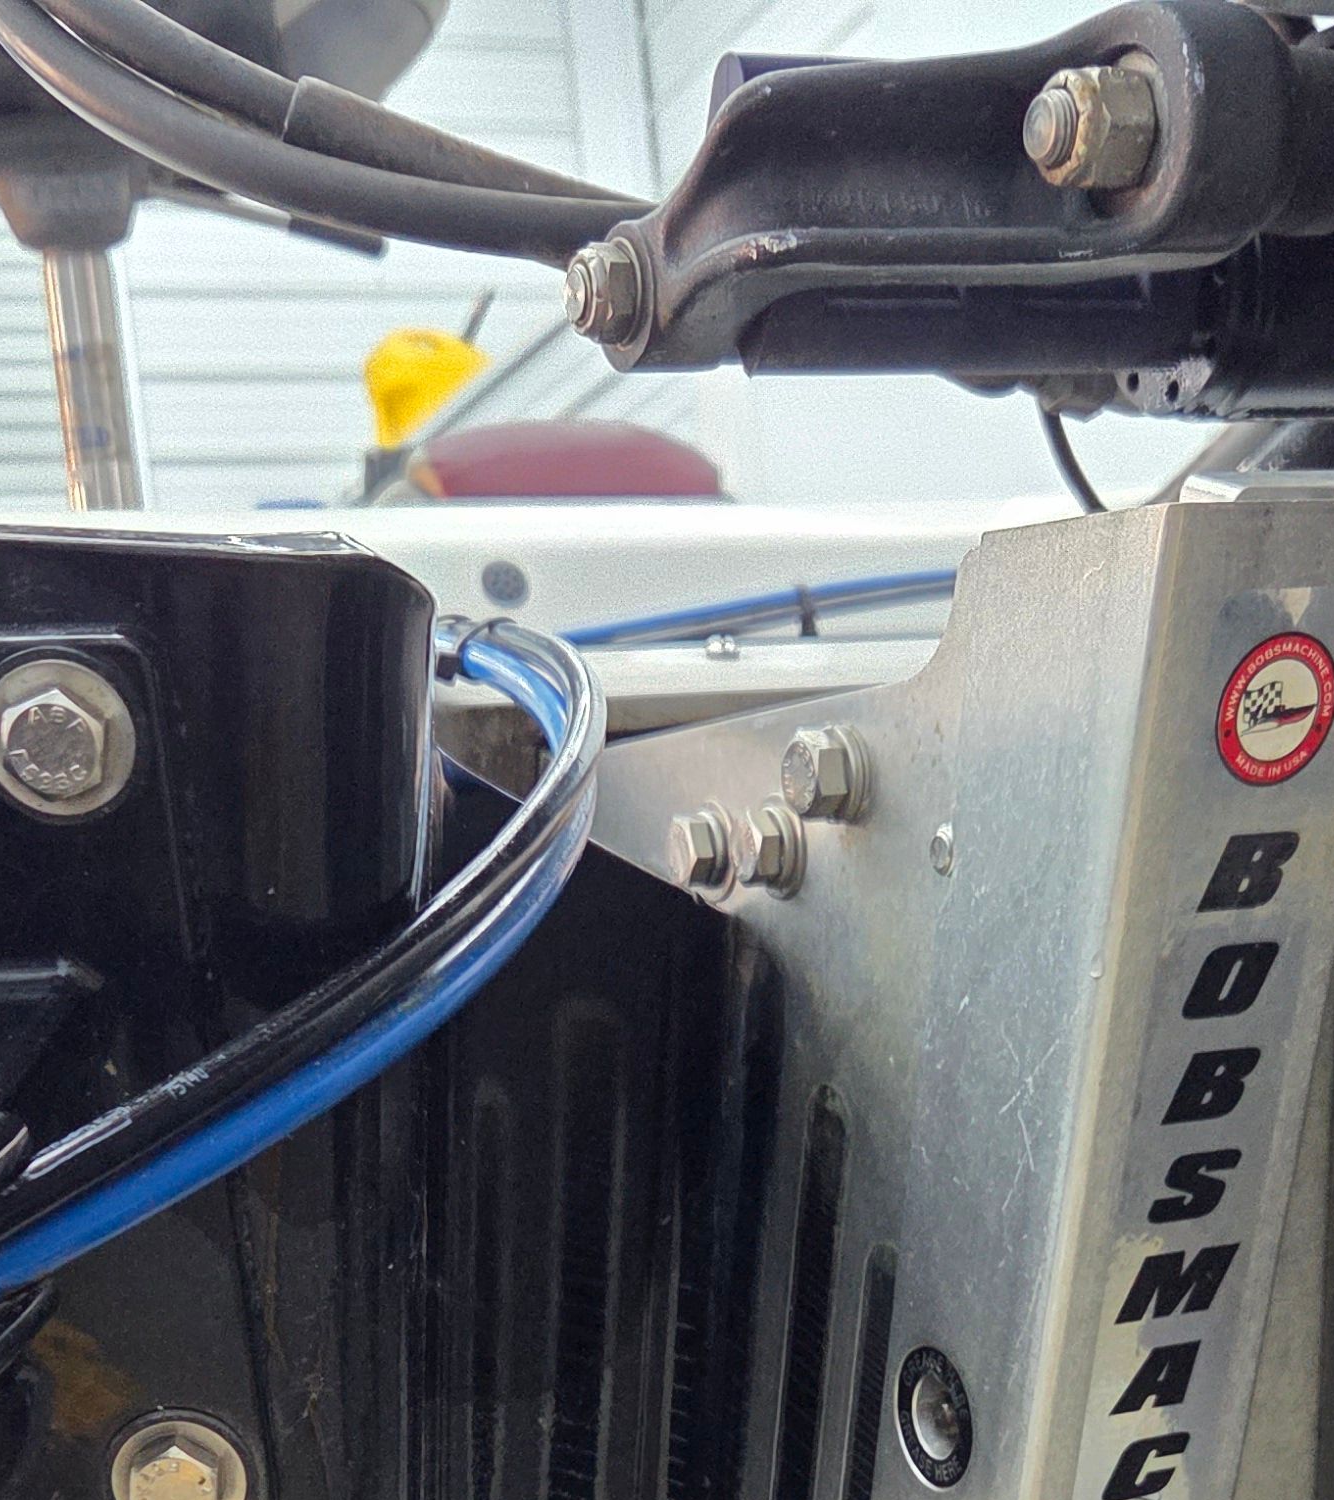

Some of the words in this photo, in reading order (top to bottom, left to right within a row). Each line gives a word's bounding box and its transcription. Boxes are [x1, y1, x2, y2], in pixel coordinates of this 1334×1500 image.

[1224, 641, 1334, 722] WWW.BOBSMACHINE.COM
[1235, 753, 1265, 777] MADE
[1268, 765, 1281, 778] IN
[1284, 750, 1308, 772] USA
[934, 1456, 963, 1481] HERE
